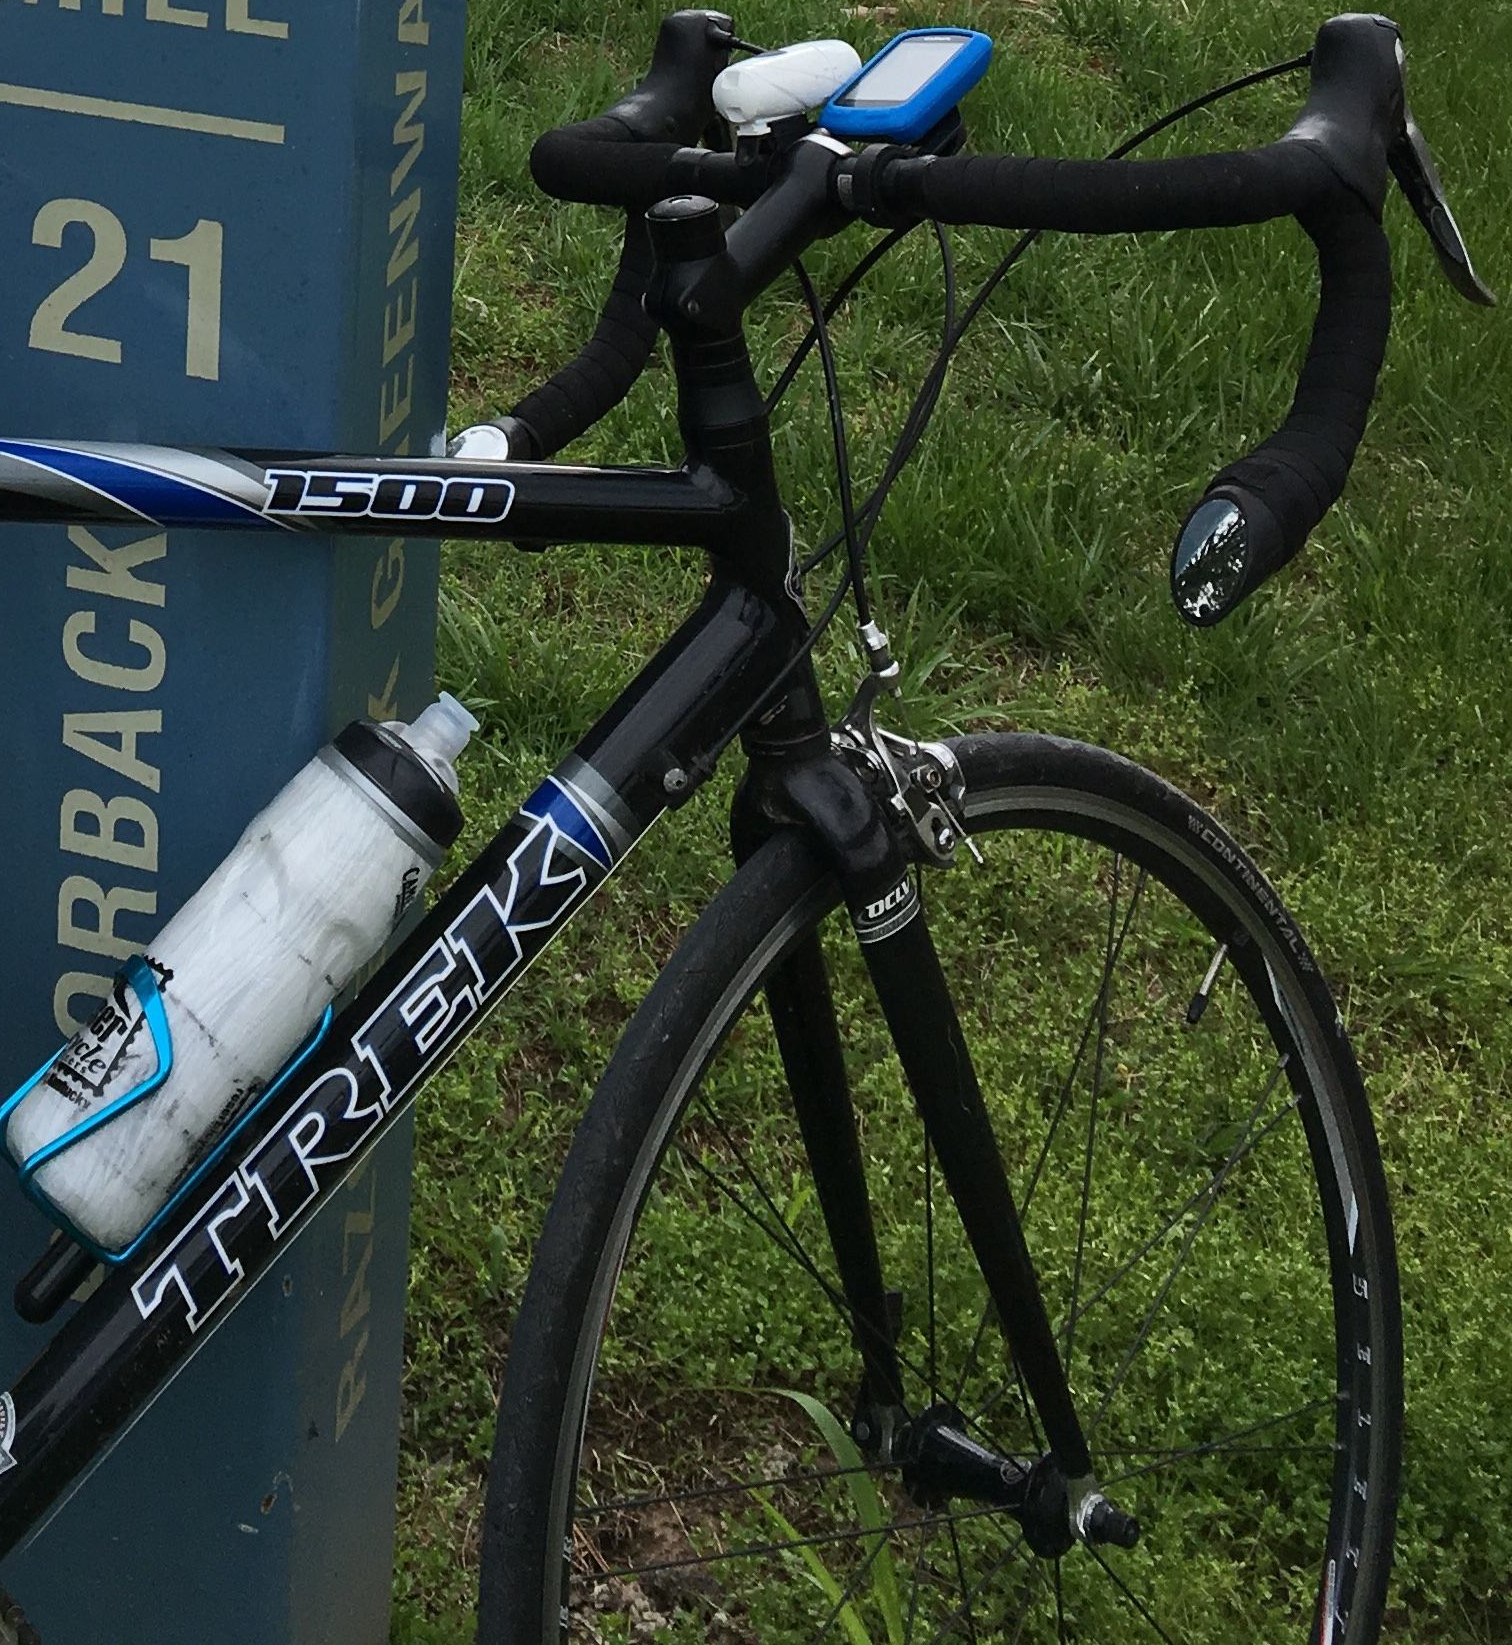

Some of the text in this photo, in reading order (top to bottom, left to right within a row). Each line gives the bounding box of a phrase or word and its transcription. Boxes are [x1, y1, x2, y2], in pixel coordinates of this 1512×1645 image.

[28, 198, 223, 381] 21
[263, 468, 515, 522] 1500
[1200, 828, 1299, 954] CONTINENTAL
[130, 812, 587, 1333] TREK
